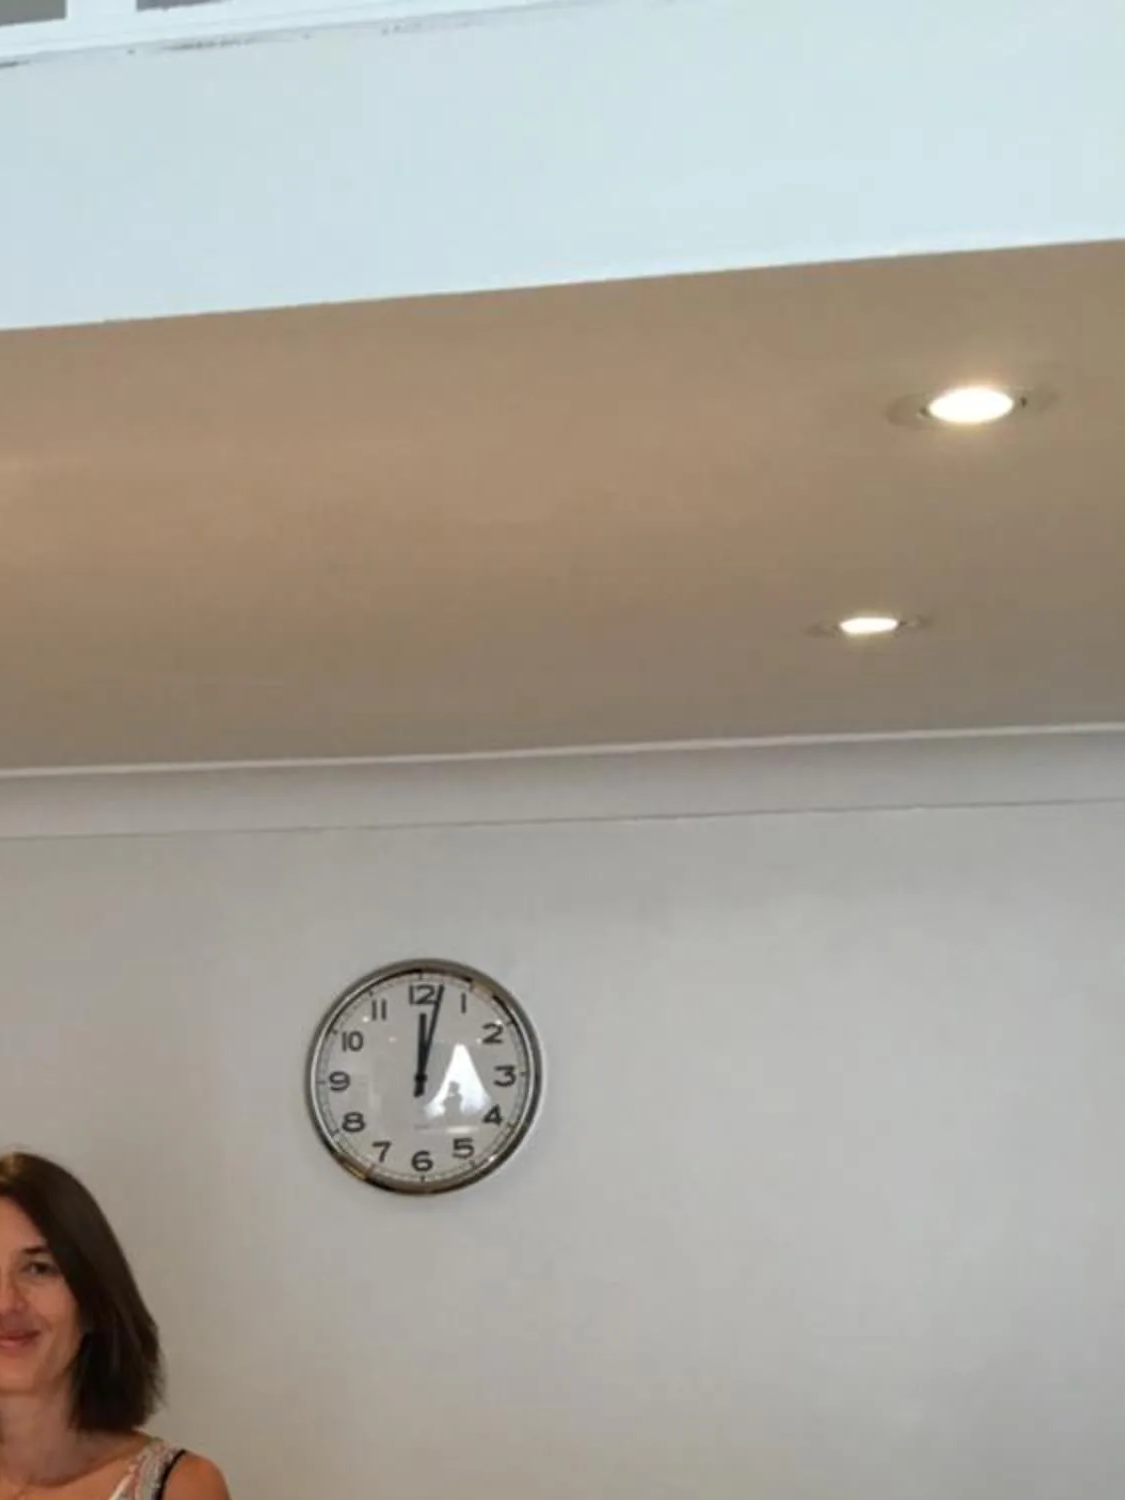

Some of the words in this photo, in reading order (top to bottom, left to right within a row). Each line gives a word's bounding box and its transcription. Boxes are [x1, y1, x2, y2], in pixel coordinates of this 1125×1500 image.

[408, 984, 436, 1005] 12
[460, 993, 467, 1013] 1
[371, 998, 387, 1021] 11
[341, 1030, 364, 1052] 10
[482, 1022, 504, 1044] 2
[328, 1071, 351, 1092] 9
[493, 1065, 516, 1087] 3
[341, 1111, 366, 1132] 8
[482, 1104, 503, 1126] 4
[372, 1141, 392, 1163] 7
[452, 1138, 475, 1159] 5
[411, 1151, 434, 1172] 6
